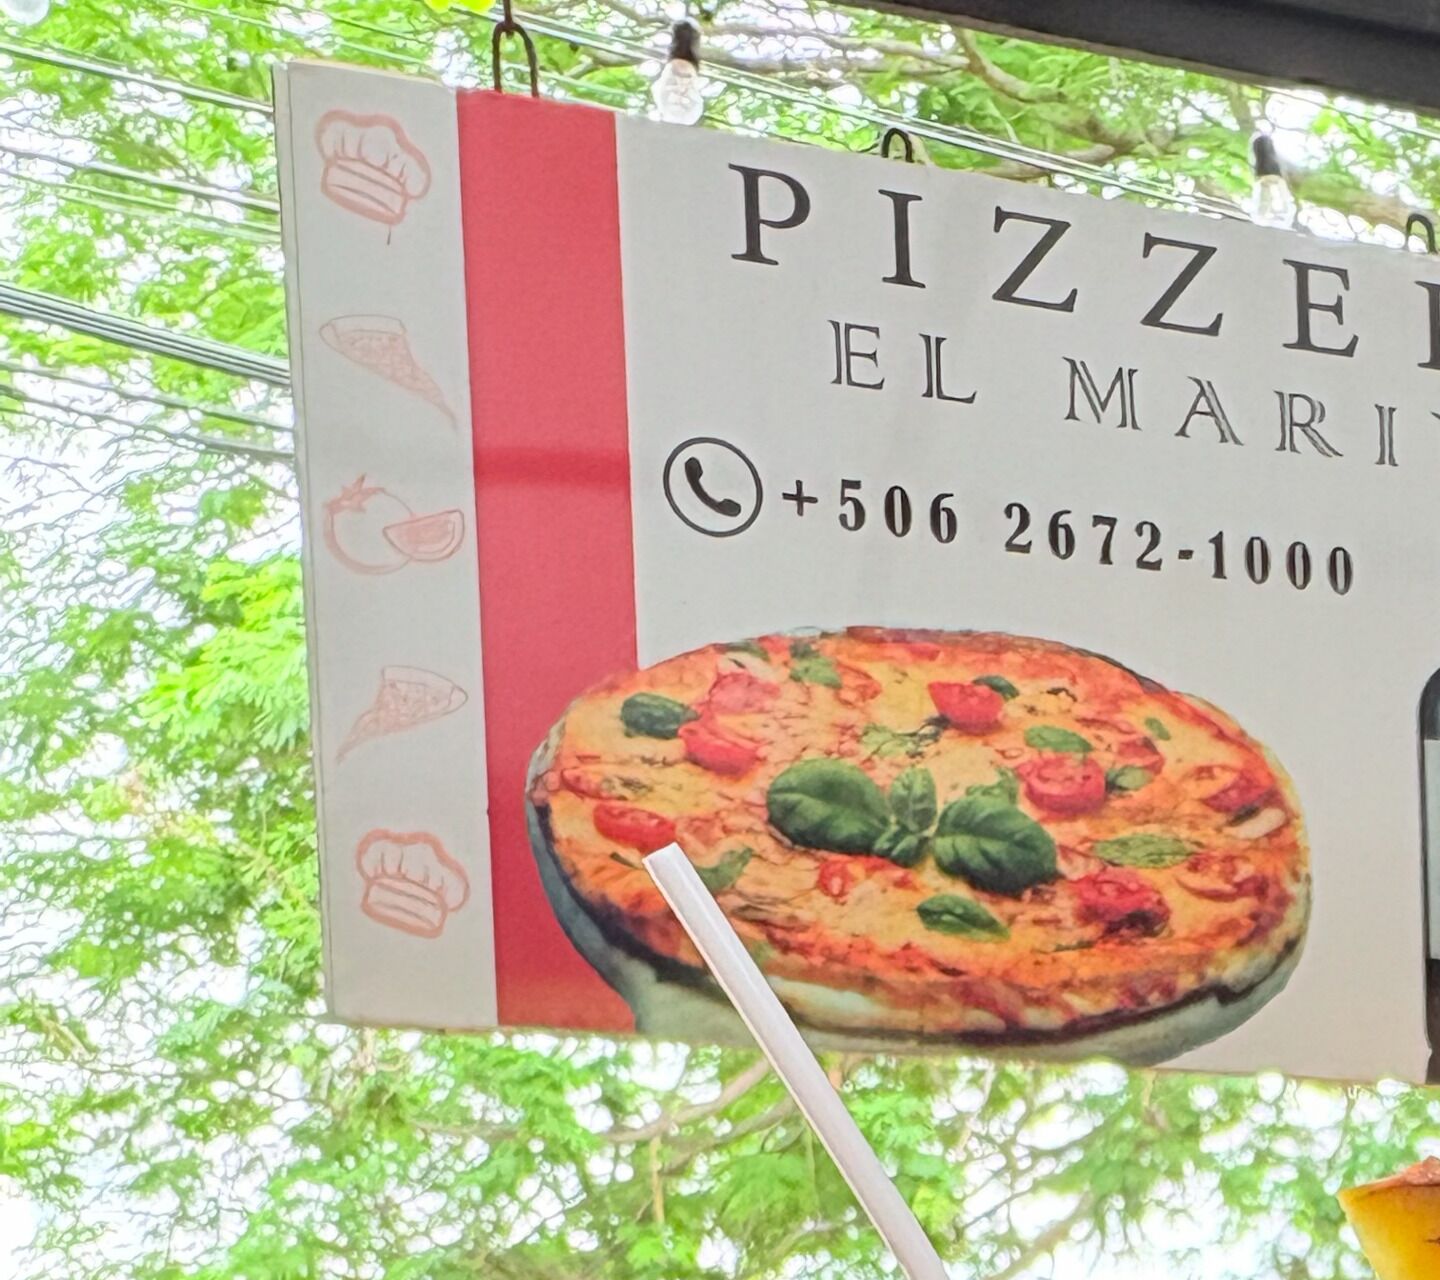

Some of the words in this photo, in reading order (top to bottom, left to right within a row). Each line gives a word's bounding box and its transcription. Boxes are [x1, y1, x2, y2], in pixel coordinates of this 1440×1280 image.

[828, 319, 978, 404] EL
[782, 479, 958, 544] +506
[1003, 502, 1354, 596] 2672-1000
